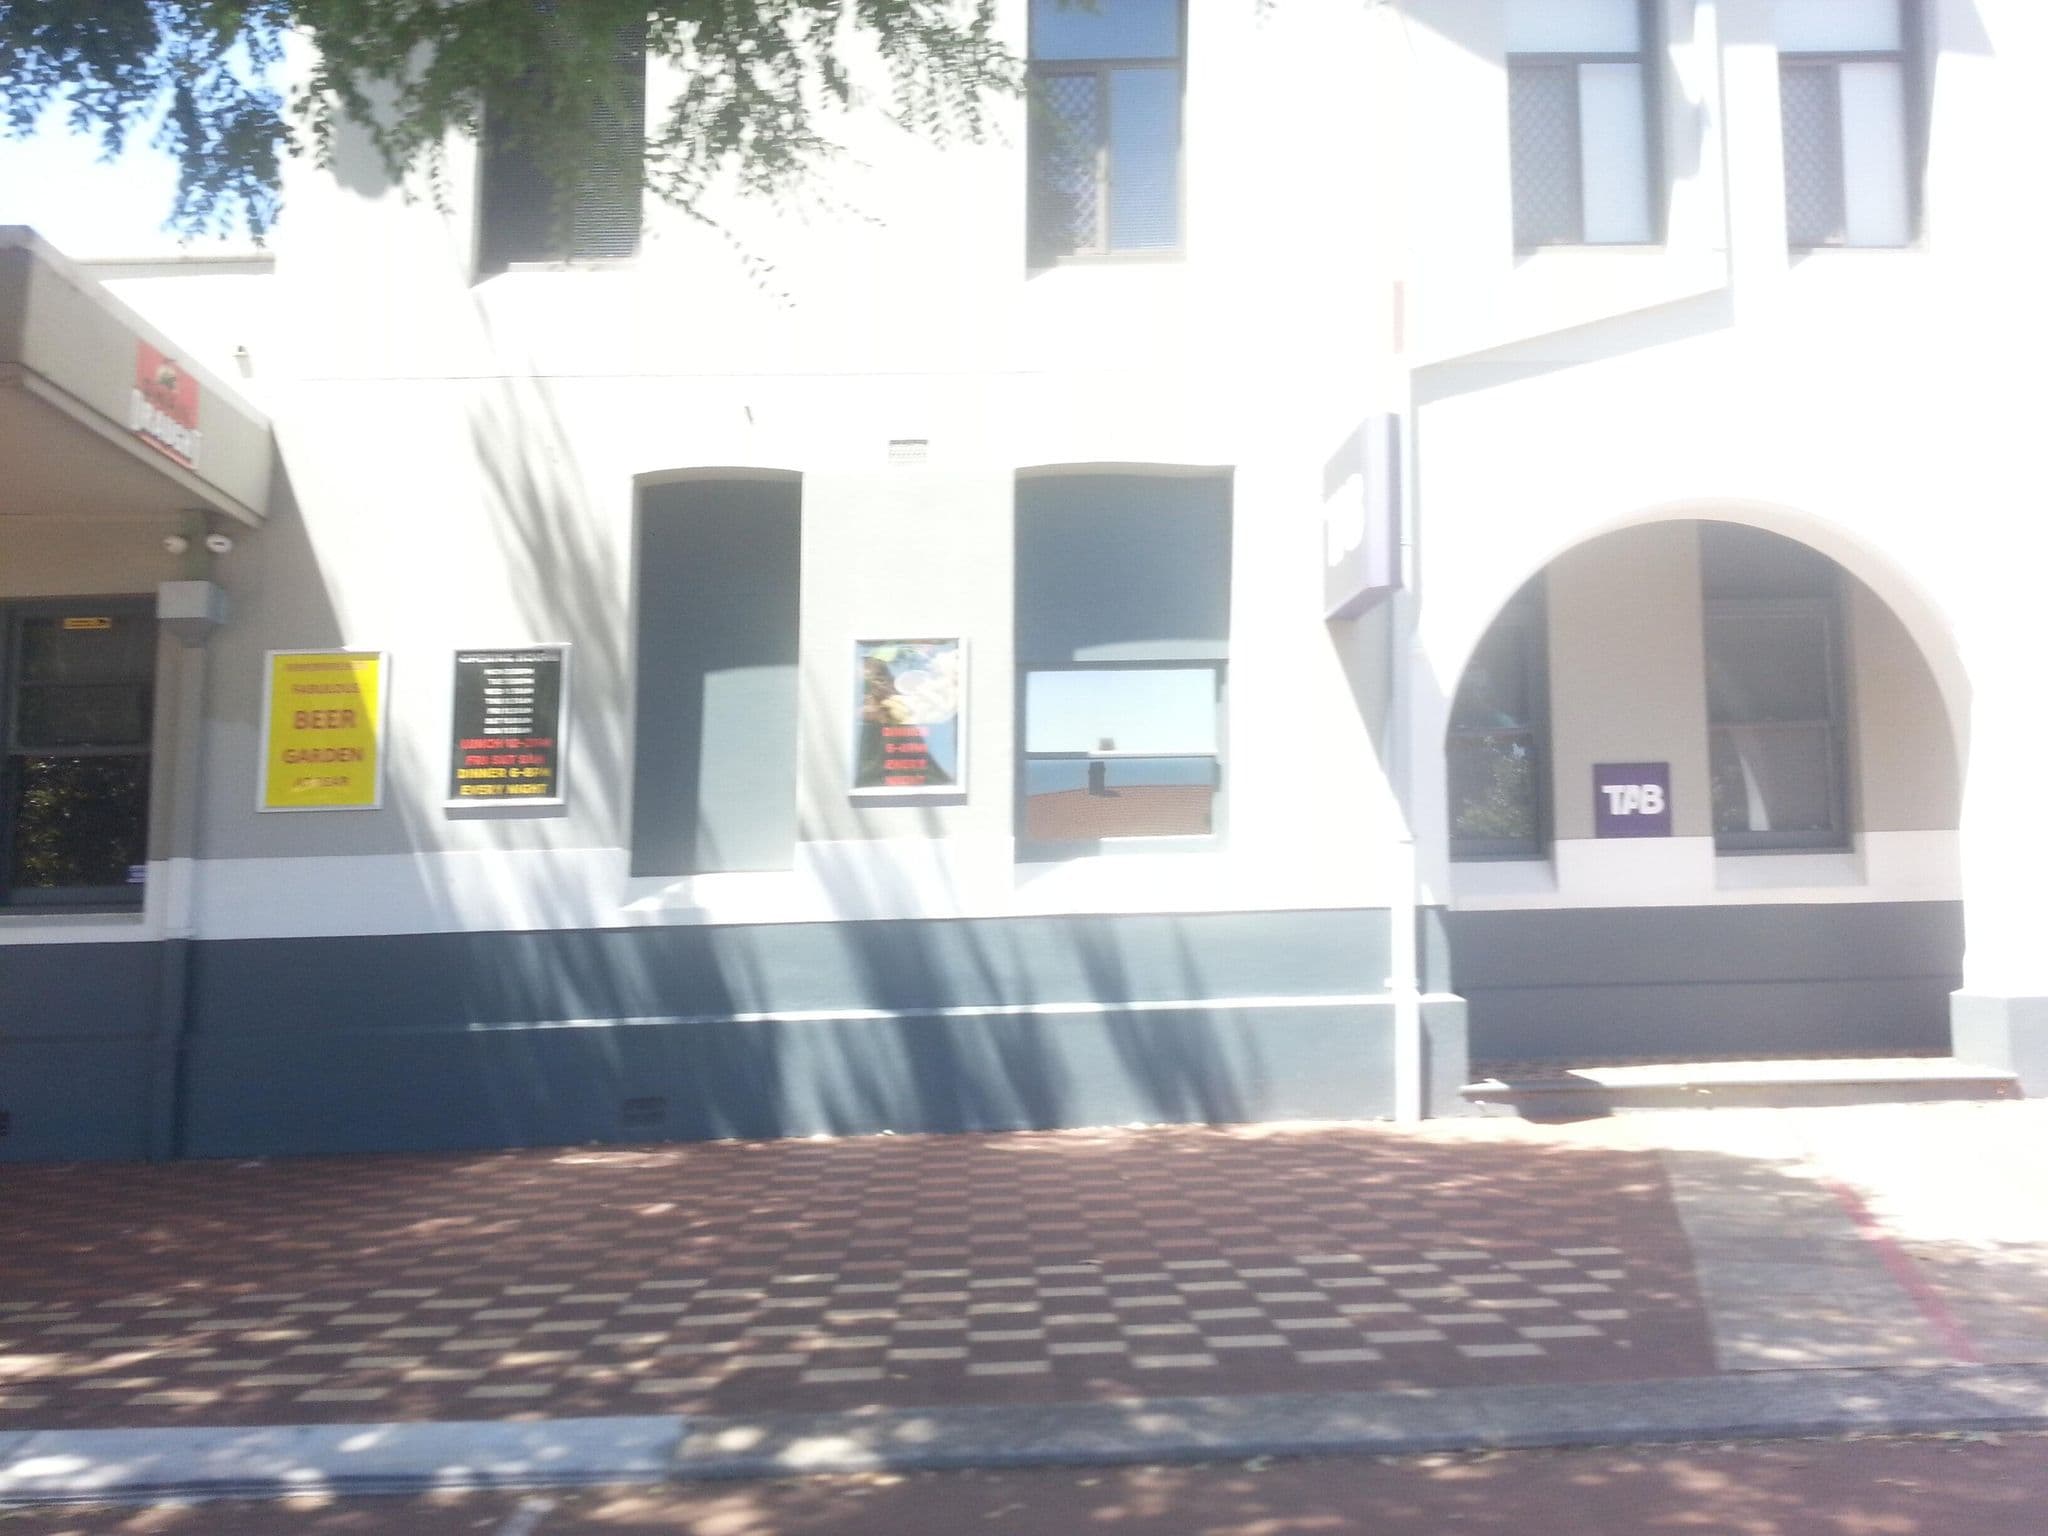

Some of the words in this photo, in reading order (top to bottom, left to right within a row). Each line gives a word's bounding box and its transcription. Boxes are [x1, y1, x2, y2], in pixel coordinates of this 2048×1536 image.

[293, 708, 357, 730] BEER
[281, 747, 365, 764] GARDEN
[1600, 784, 1666, 816] TAB
